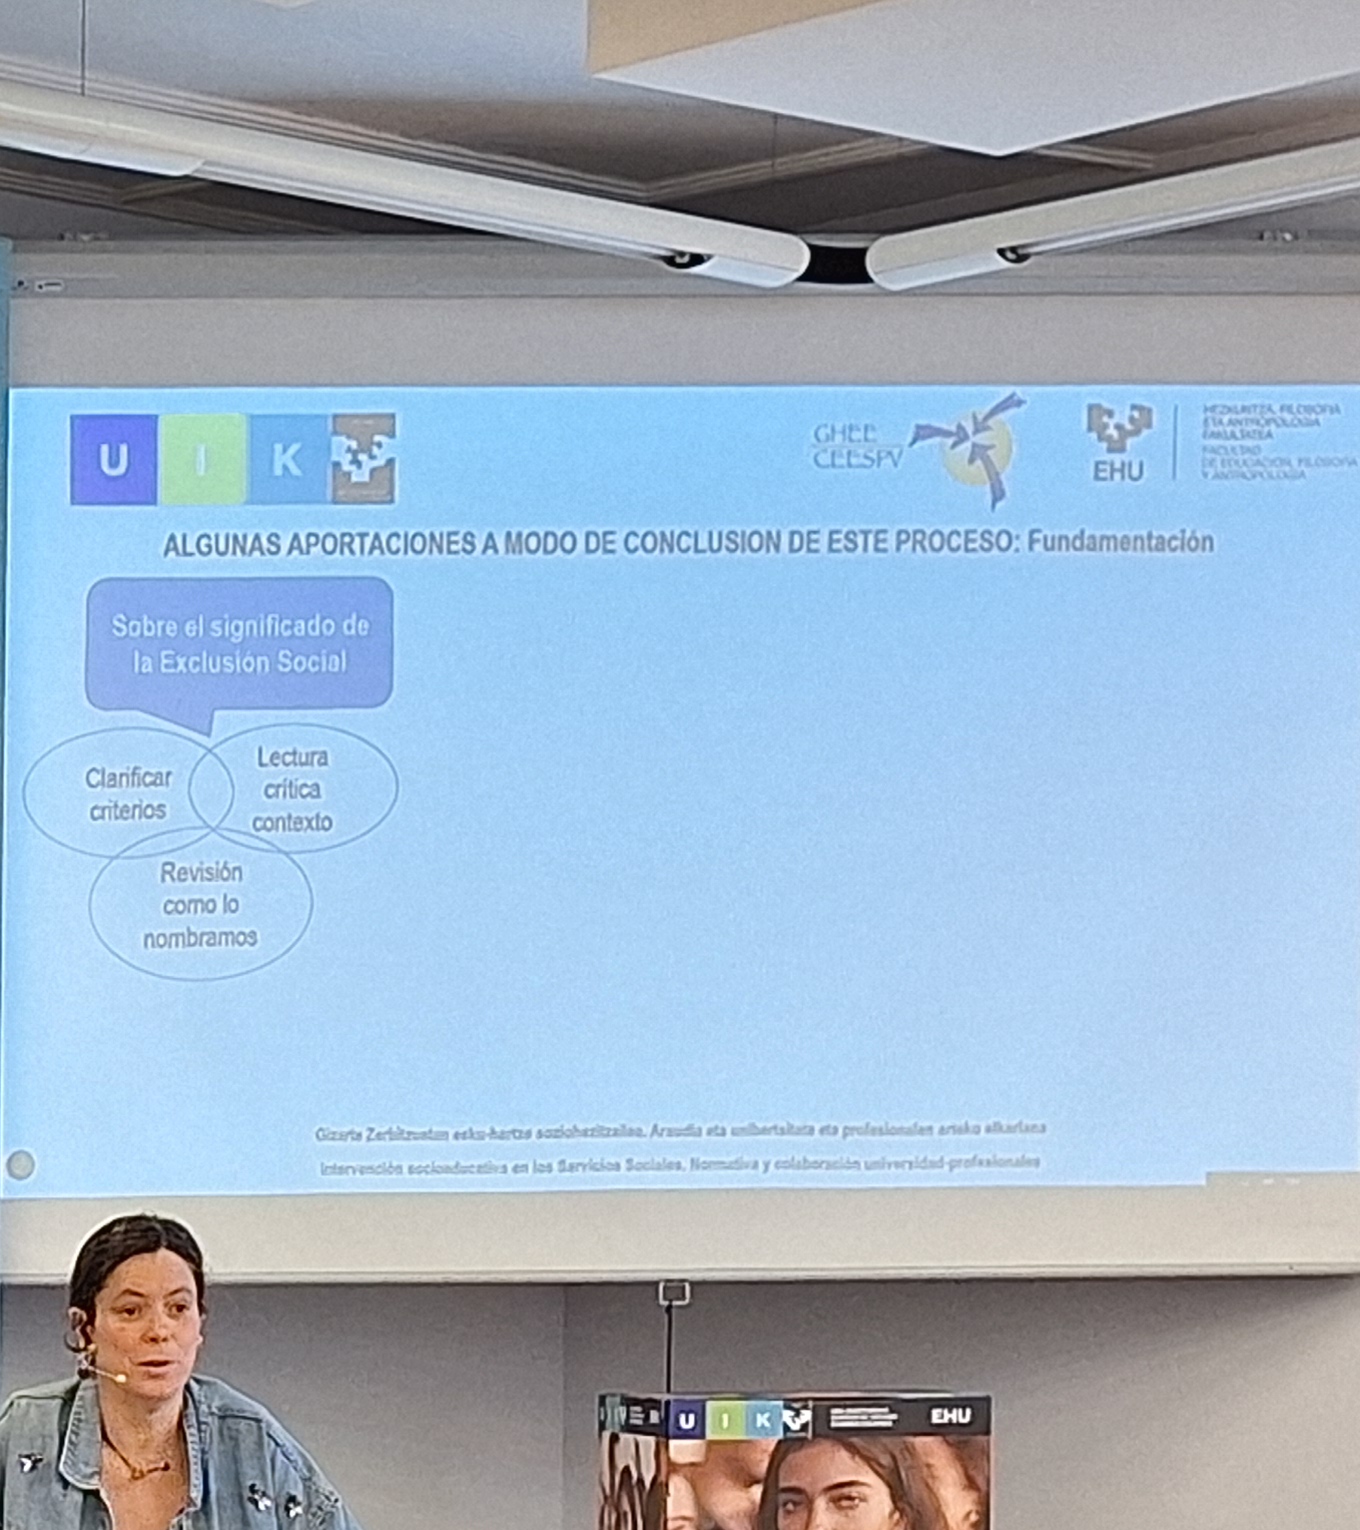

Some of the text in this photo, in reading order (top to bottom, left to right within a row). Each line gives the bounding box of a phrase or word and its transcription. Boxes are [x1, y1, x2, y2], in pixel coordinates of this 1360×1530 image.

[1093, 460, 1144, 481] EHU
[164, 528, 1214, 557] ALGUNAS APORTACIONES A MODO DE CONCLUSION DE ESTE PROCESO: Fundamentación
[112, 614, 369, 643] Sobre el significado de
[134, 649, 346, 673] la Exclusión Social
[257, 747, 328, 769] Lectura
[86, 767, 171, 789] Clarificar
[90, 799, 166, 821] criterios
[252, 812, 333, 833] contexto
[161, 860, 242, 884] Revisión
[163, 894, 239, 915] como lo
[144, 926, 257, 950] nombramos
[930, 1408, 971, 1424] EHU
